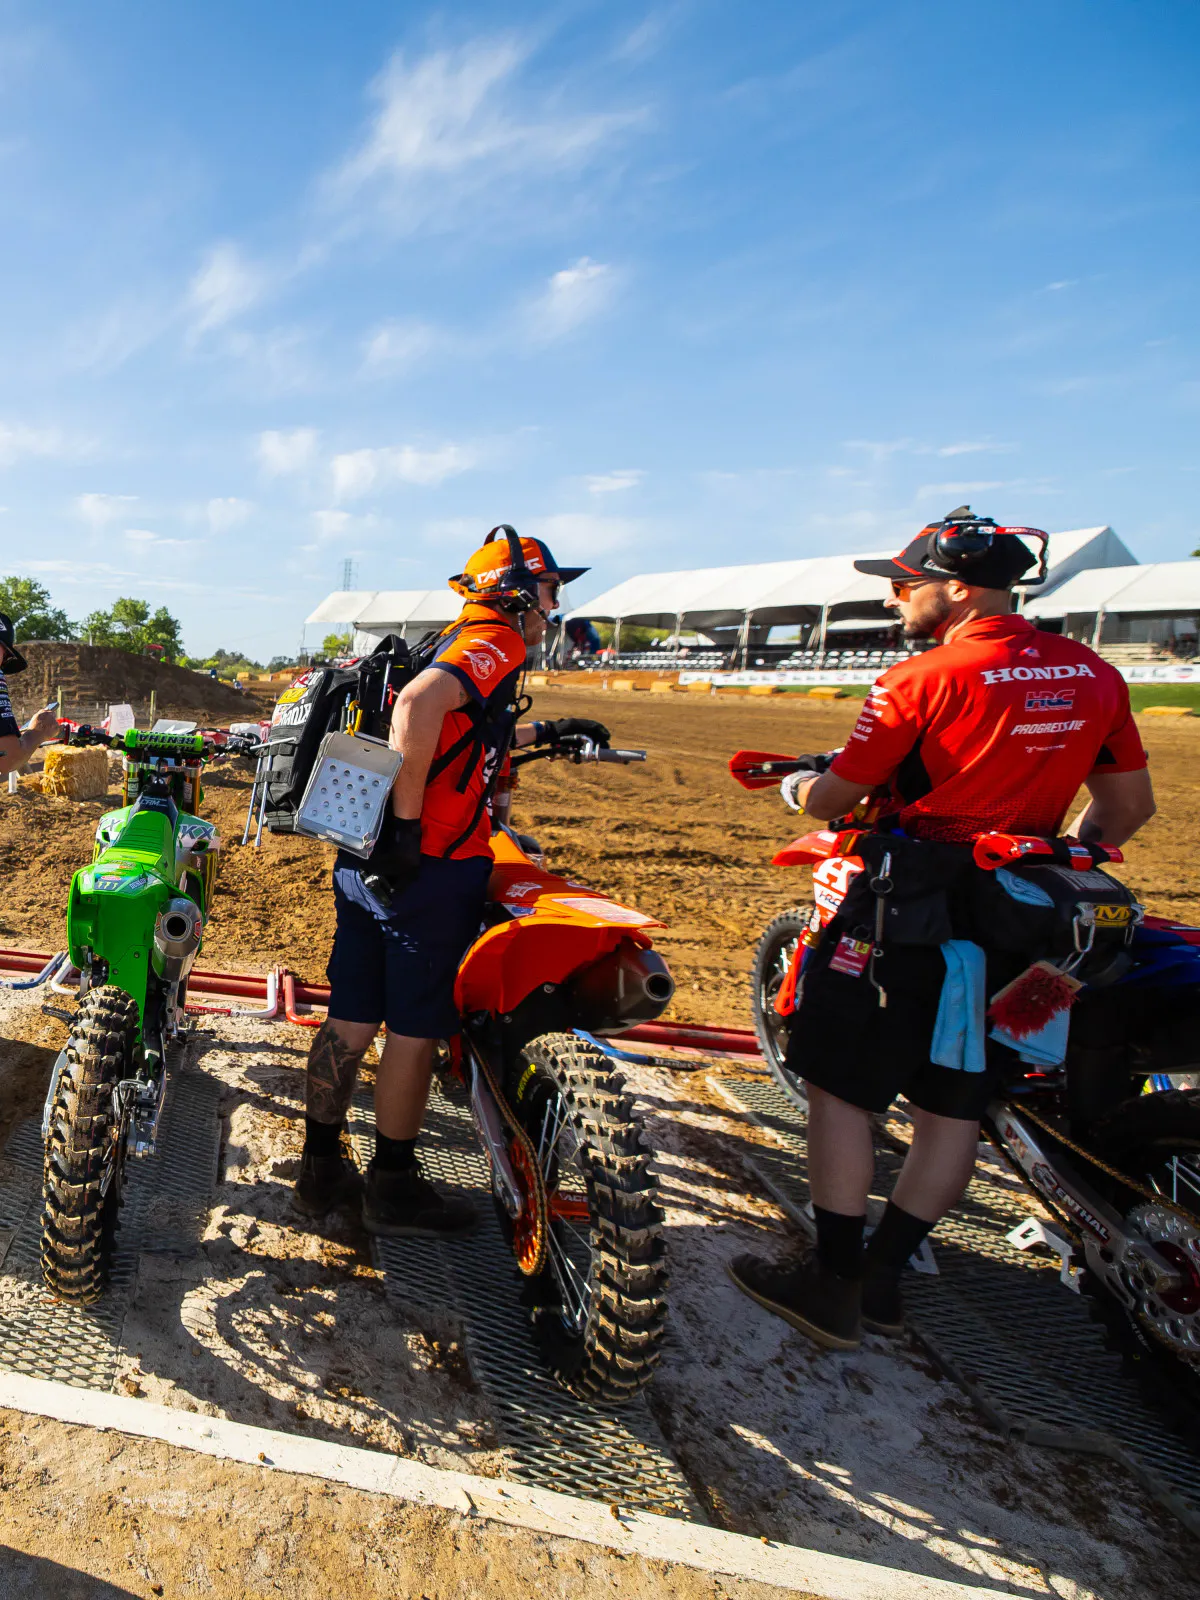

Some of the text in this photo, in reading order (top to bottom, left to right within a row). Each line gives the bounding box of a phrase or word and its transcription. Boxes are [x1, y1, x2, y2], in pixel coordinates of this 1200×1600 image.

[980, 663, 1097, 685] HONDA
[1024, 688, 1076, 709] HRC
[137, 733, 196, 744] RENTHA
[180, 824, 215, 840] KX
